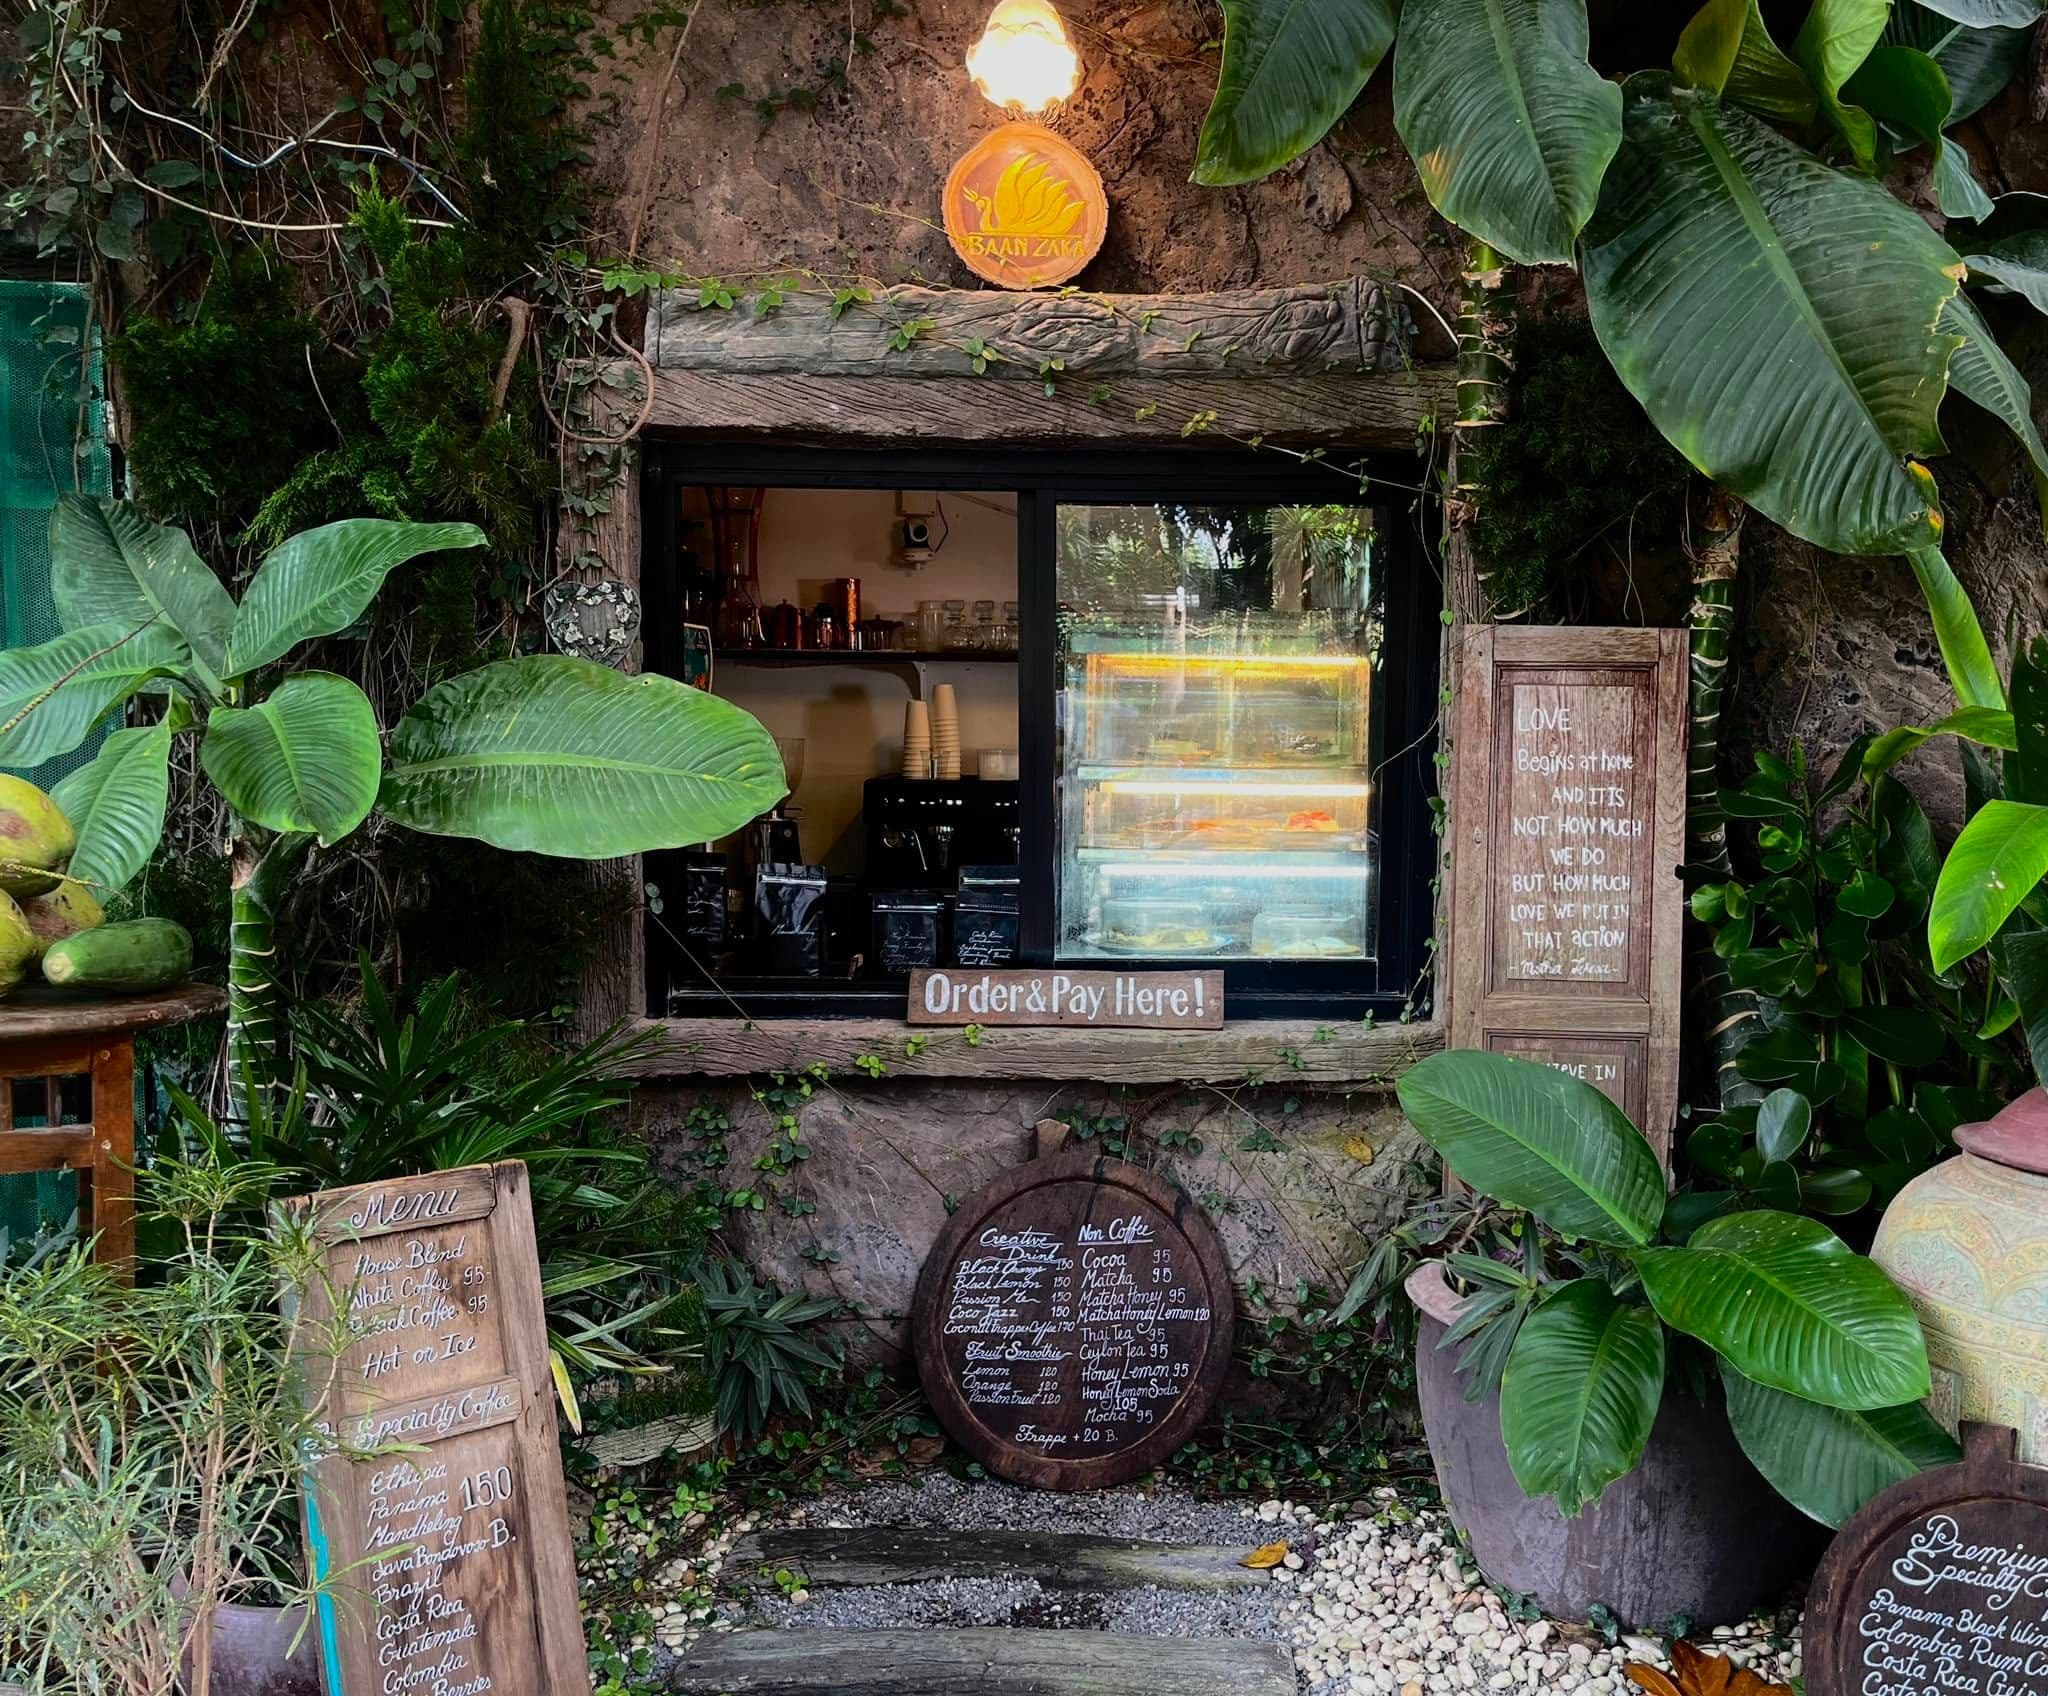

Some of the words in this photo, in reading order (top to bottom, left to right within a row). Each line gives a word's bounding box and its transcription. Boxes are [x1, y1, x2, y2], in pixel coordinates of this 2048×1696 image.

[968, 236, 1028, 257] BAAN
[1032, 237, 1086, 257] ZAKA
[1517, 706, 1572, 732] LOVE
[1579, 751, 1598, 773] at
[1551, 785, 1584, 805] AND
[1513, 815, 1550, 837] NOT
[1558, 815, 1597, 834] HOW
[1600, 816, 1642, 837] MUCH
[1550, 846, 1575, 866] WE
[1581, 847, 1606, 866] DO
[1512, 873, 1545, 892] BUT
[1552, 873, 1589, 892] HOW
[1592, 874, 1631, 893] MUCH
[1510, 903, 1545, 922] LOVE
[1553, 903, 1576, 920] WE
[1582, 903, 1609, 921] PUT
[1611, 903, 1630, 920] IN
[1522, 930, 1562, 950] THAT
[1115, 976, 1205, 1018] Here!
[1594, 1064, 1616, 1081] IN
[350, 1188, 461, 1230] Menu
[980, 1225, 1058, 1248] Creative
[1078, 1223, 1105, 1241] Non
[1108, 1215, 1156, 1244] Coffee
[353, 1253, 403, 1276] House
[405, 1235, 466, 1269] Blend
[1000, 1244, 1061, 1262] Drink
[1082, 1247, 1128, 1269] Cocoa
[1152, 1249, 1171, 1264] 95
[956, 1259, 1000, 1275] Black
[1081, 1267, 1135, 1289] Matcha
[1152, 1267, 1172, 1283] 95
[401, 1268, 452, 1306] Coffee
[953, 1275, 993, 1290] Black
[993, 1272, 1043, 1289] Lemon
[1053, 1276, 1072, 1289] 150
[952, 1288, 1001, 1304] Passion
[1002, 1288, 1041, 1304] Me
[1051, 1291, 1072, 1303] 150
[1079, 1286, 1125, 1307] Matcha
[1127, 1285, 1163, 1307] Honey
[1168, 1287, 1186, 1303] 95
[410, 1296, 459, 1331] Coffee
[467, 1294, 488, 1315] 95
[949, 1304, 981, 1320] Coco
[981, 1304, 1019, 1324] Jazz
[1051, 1305, 1070, 1318] 150
[1157, 1302, 1194, 1321] Lemon
[1194, 1307, 1210, 1321] 120
[1057, 1321, 1076, 1334] 170
[1080, 1326, 1111, 1342] Thai
[1111, 1323, 1135, 1340] Tea
[1146, 1328, 1165, 1342] 95
[361, 1344, 408, 1379] Hot
[413, 1345, 439, 1365] or
[439, 1332, 478, 1361] Ice
[965, 1340, 1006, 1360] Fruit
[1005, 1340, 1068, 1361] Smoothie
[1079, 1341, 1122, 1370] Ceylon
[1122, 1338, 1146, 1358] Tea
[1150, 1343, 1168, 1359] 95
[962, 1361, 1010, 1376] Lemon
[1040, 1366, 1058, 1377] 120
[1081, 1366, 1120, 1383] Honey
[1121, 1358, 1168, 1380] Lemon
[1172, 1363, 1190, 1378] 95
[962, 1374, 1012, 1392] Orange
[1038, 1381, 1058, 1392] 120
[1148, 1378, 1180, 1398] Soda
[1041, 1394, 1061, 1405] 120
[1114, 1397, 1138, 1412] 105
[353, 1399, 457, 1450] Specialty
[458, 1384, 518, 1426] Coffee
[1085, 1407, 1128, 1423] Mocha
[1136, 1409, 1154, 1424] 95
[1015, 1424, 1067, 1450] Frappe
[1083, 1427, 1100, 1442] 20
[459, 1465, 514, 1512] 150
[367, 1488, 450, 1528] Panama
[364, 1508, 464, 1551] Mandheling
[372, 1556, 414, 1582] Java
[1892, 1548, 2026, 1611] Specialty
[371, 1563, 442, 1611] Brazil
[376, 1603, 425, 1641] Costa
[426, 1593, 466, 1621] Rica
[1869, 1588, 1955, 1628] Panama
[1956, 1609, 2007, 1640] Black
[379, 1614, 480, 1667] Guatemala
[1859, 1612, 1964, 1660] Colombia
[1969, 1636, 2023, 1673] Rum
[384, 1646, 469, 1695] Colombia
[1863, 1641, 1927, 1680] Costa
[1934, 1656, 1980, 1694] Rica
[431, 1675, 492, 1696] Berries
[1862, 1671, 1918, 1696] Cost
